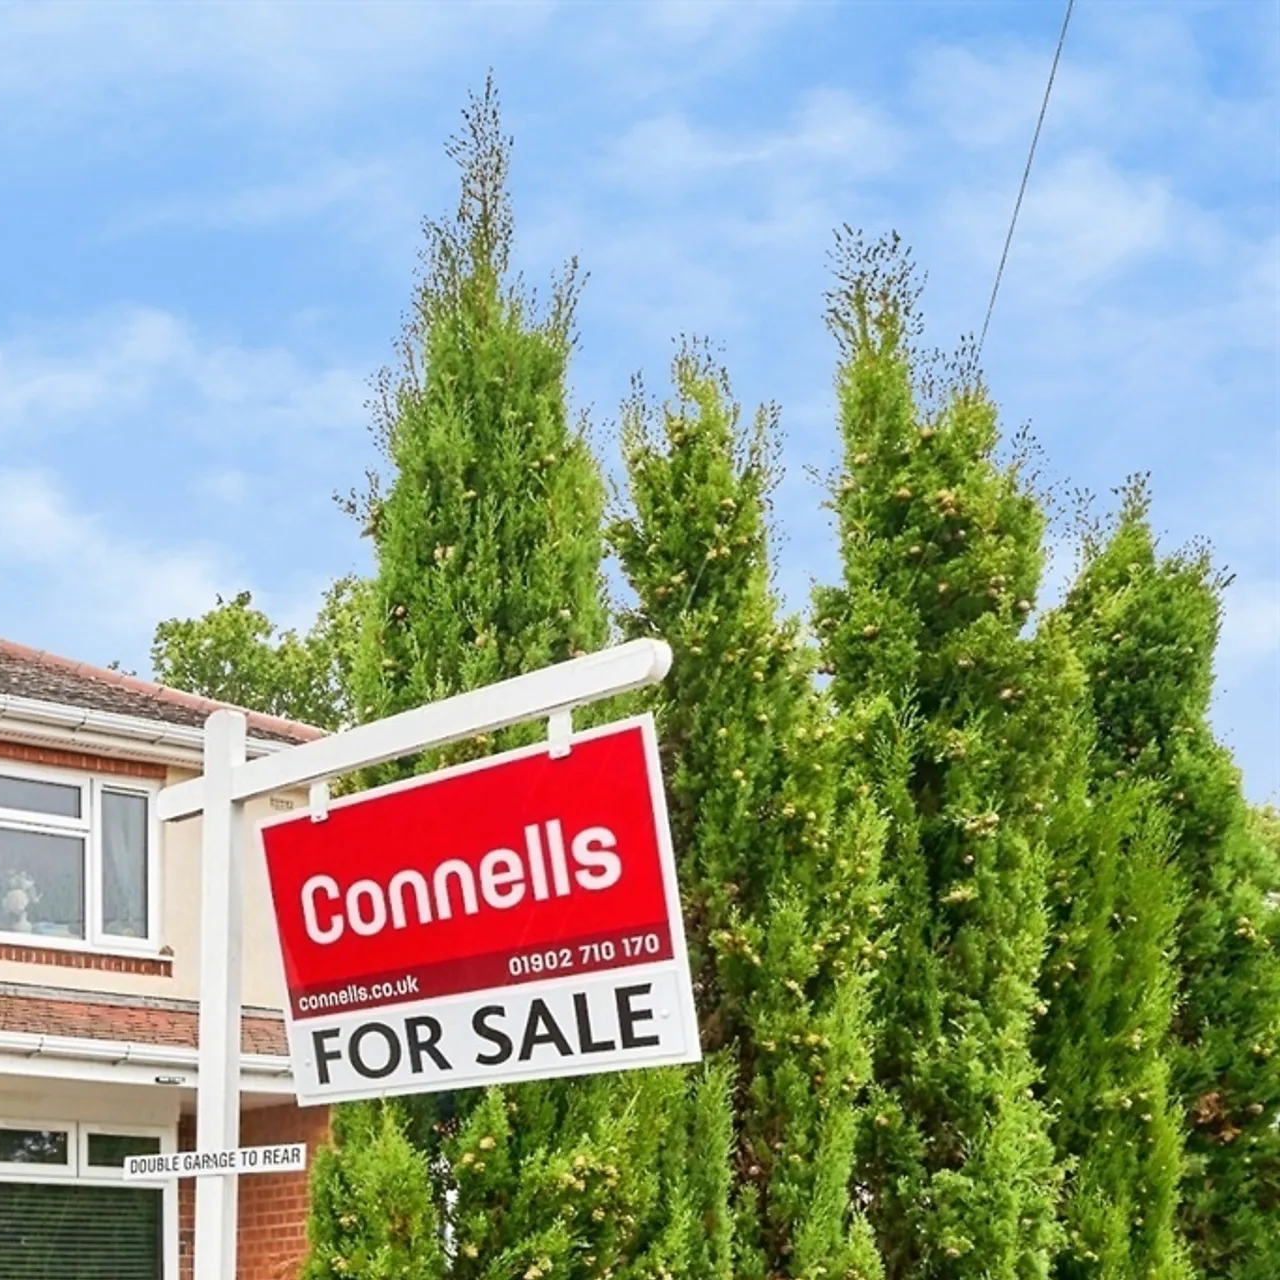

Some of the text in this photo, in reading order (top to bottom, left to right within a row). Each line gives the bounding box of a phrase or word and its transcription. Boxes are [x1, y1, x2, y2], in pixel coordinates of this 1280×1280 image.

[301, 820, 622, 944] Connells
[508, 933, 661, 976] 01902 710 170
[298, 974, 420, 1011] connells.co.uk
[312, 982, 661, 1085] FOR SALE
[130, 1147, 301, 1174] DOUBLE GARAGE TO REAR
